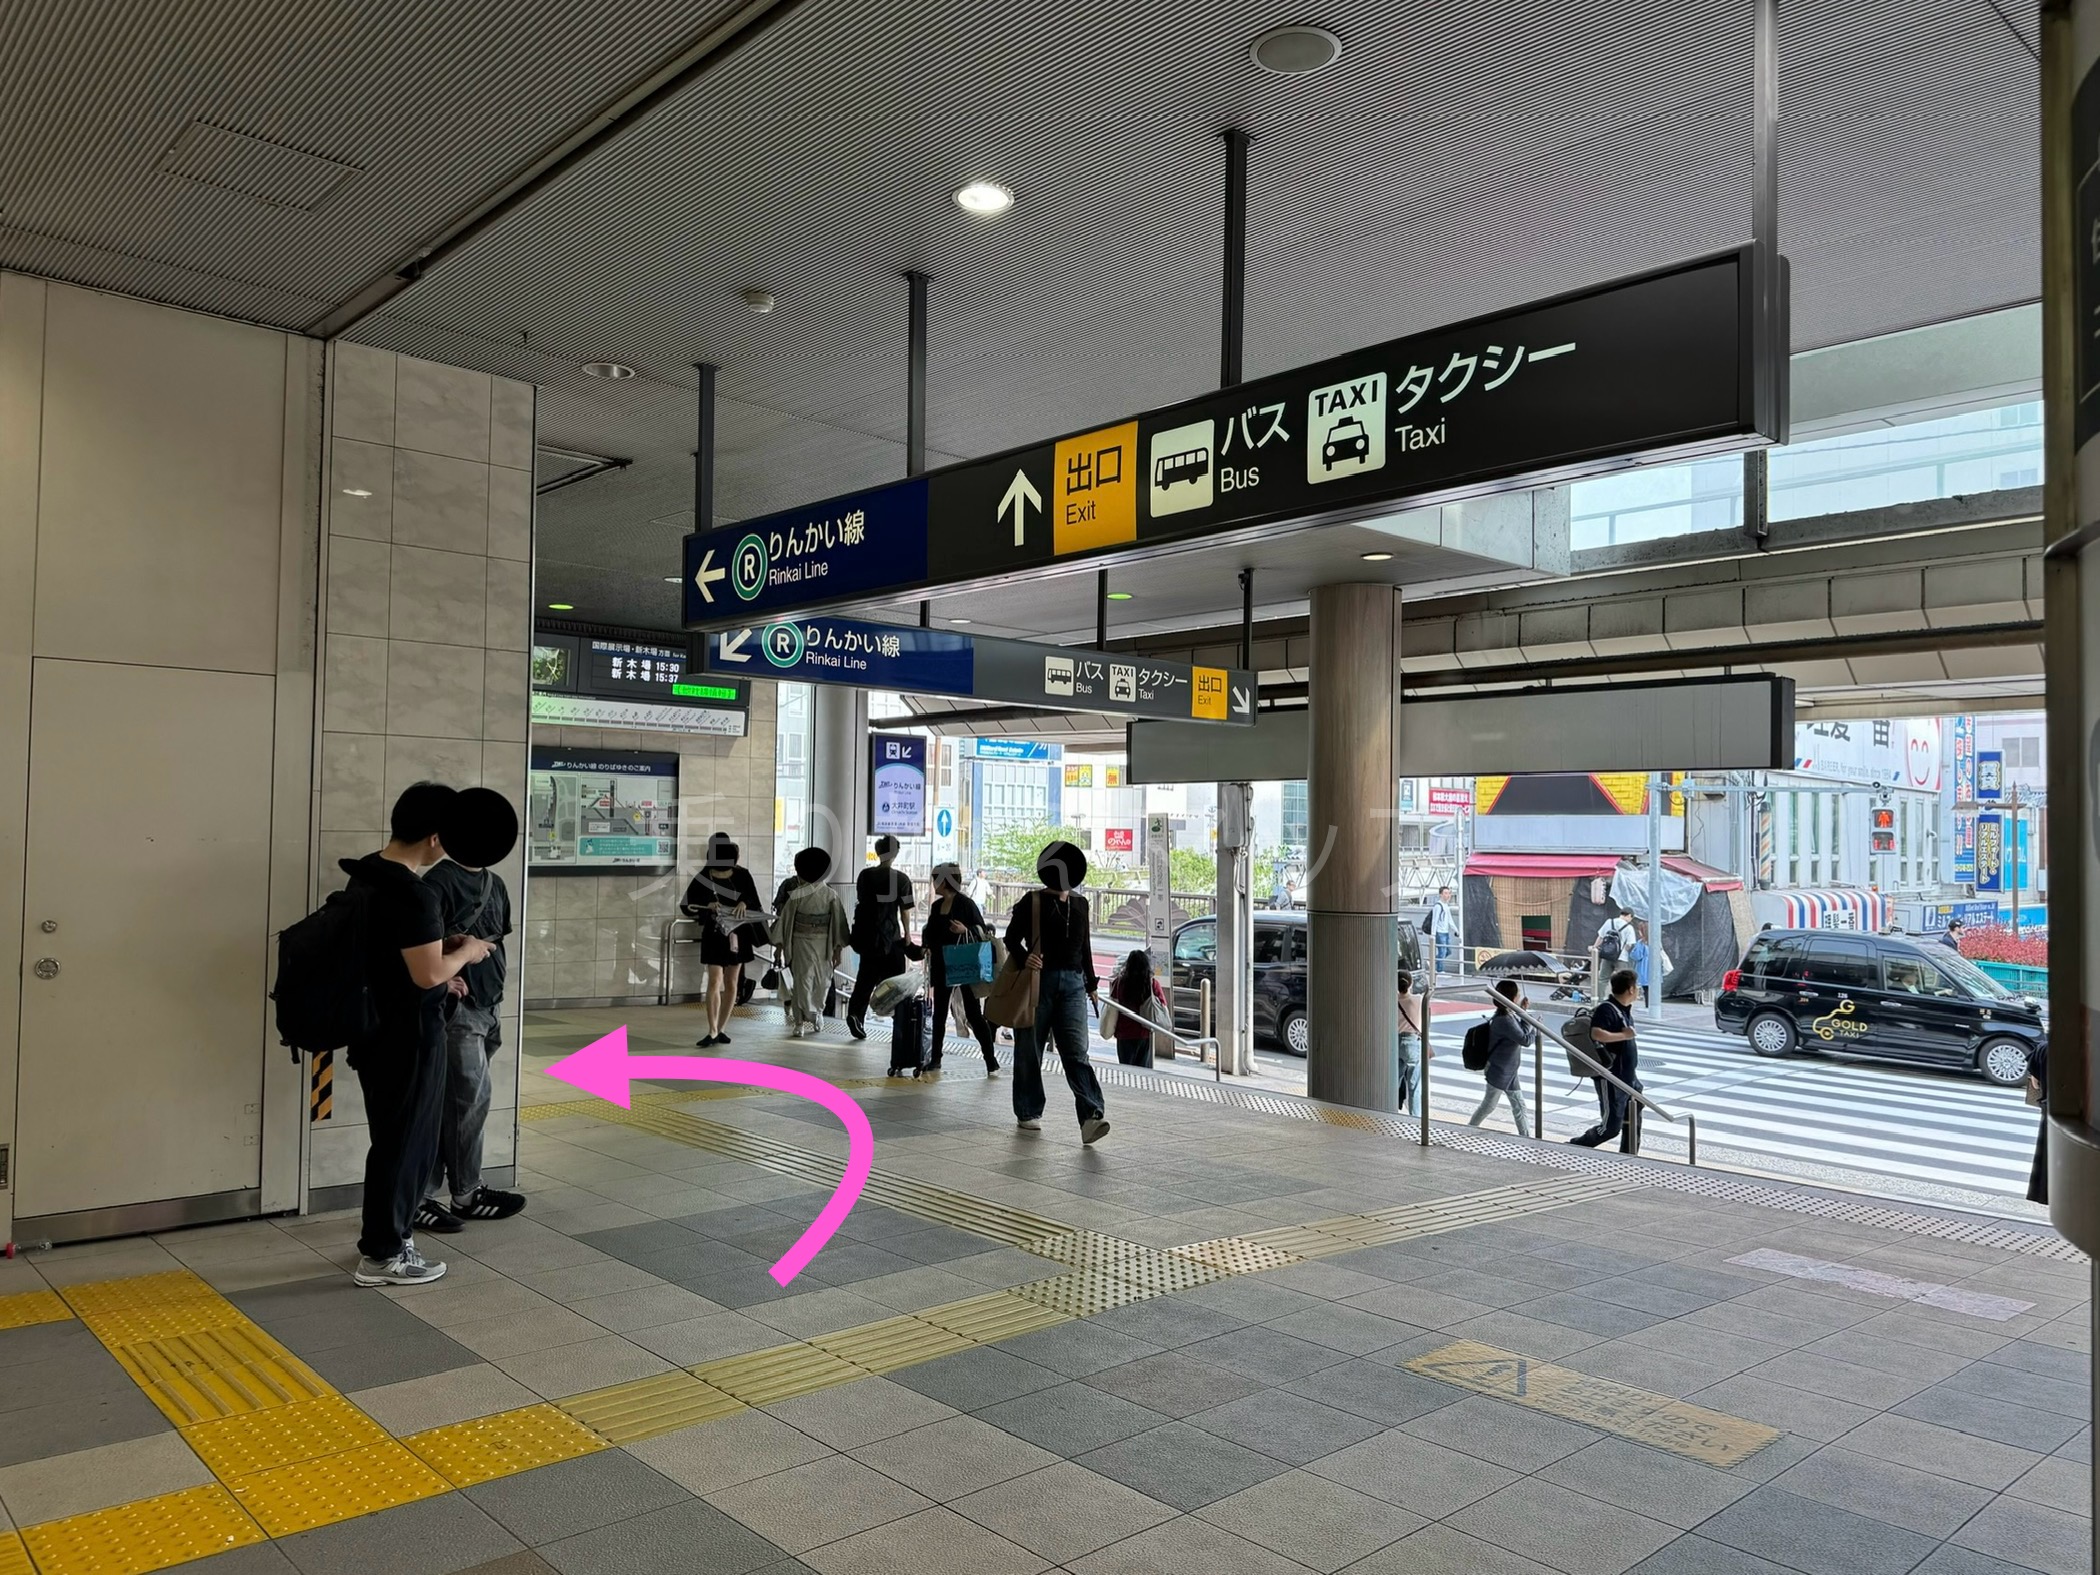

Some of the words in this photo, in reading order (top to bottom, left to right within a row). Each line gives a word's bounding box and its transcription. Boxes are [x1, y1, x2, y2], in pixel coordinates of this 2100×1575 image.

[1395, 342, 1577, 415] タクシー
[1314, 379, 1379, 418] TAXI
[1220, 402, 1290, 456] バス
[1395, 418, 1446, 452] Taxi
[1066, 445, 1124, 496] 出口
[1221, 464, 1260, 493] Bus
[1066, 500, 1097, 525] Exit
[768, 509, 866, 561] りんかい線
[743, 554, 756, 580] R
[769, 563, 802, 587] Rinkai
[804, 559, 829, 580] Line
[777, 630, 790, 654] R
[805, 625, 901, 658] りんかい線
[612, 656, 651, 671] 新木場
[656, 661, 680, 673] 15:30
[805, 651, 841, 668] Rinkai
[843, 655, 868, 671] Line
[1077, 660, 1104, 681] バス
[1111, 664, 1135, 678] TAXI
[611, 668, 651, 682] 新木場
[655, 672, 679, 684] 15:37
[1138, 667, 1189, 688] タクシー
[1197, 674, 1223, 694] 出口
[1076, 681, 1093, 694] Bus
[1138, 688, 1155, 701] Taxi
[1197, 694, 1212, 707] Exit
[567, 762, 597, 770] りんかい線
[893, 782, 921, 790] りんかい線
[1831, 1018, 1868, 1032] GOLD
[1839, 1029, 1860, 1038] TAXI
